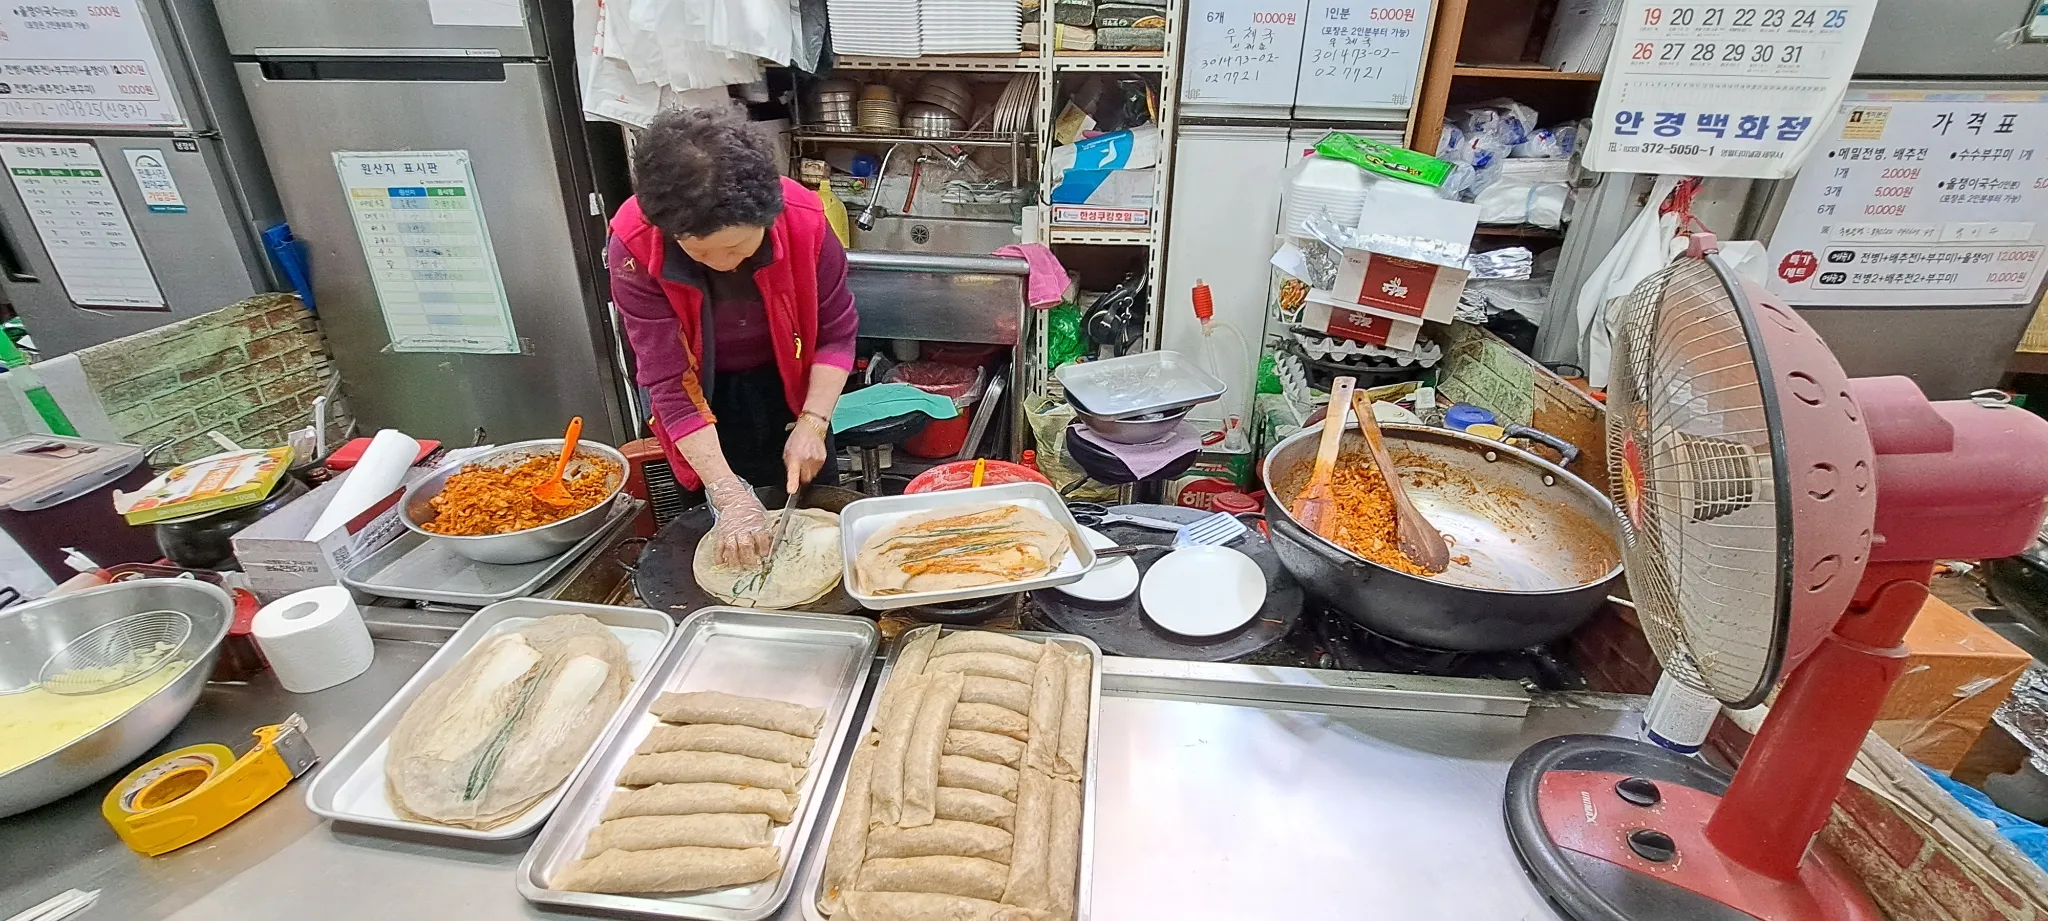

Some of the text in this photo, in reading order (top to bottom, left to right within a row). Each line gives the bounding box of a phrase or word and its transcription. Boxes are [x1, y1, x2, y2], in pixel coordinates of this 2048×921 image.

[1206, 12, 1297, 25] 6개 10,000원
[1325, 7, 1415, 22] 1인분 5,000원
[1643, 8, 1848, 28] 19 20 21 22 23 24 25
[1351, 27, 1388, 37] 2인분부터
[1391, 28, 1410, 38] 가능)
[1631, 42, 1654, 60] 26
[1659, 43, 1685, 61] 27
[1690, 44, 1716, 62] 28
[1722, 44, 1746, 62] 29
[1751, 44, 1774, 62] 30
[1781, 45, 1803, 64] 31
[1614, 110, 1813, 142] 안경백화점
[1641, 142, 1715, 156] 372-5050~1
[1893, 148, 1929, 161] 배추전
[1958, 148, 2034, 161] 수수부꾸미 1개
[361, 162, 438, 175] 원산지 표시판
[1834, 167, 1922, 180] 1개 2,000원
[1823, 186, 1914, 198] 3개 5,000원
[1079, 210, 1133, 222] 한성쿠킹호일
[1817, 204, 1906, 216] 6개 10,000원
[1997, 251, 2037, 263] 12,000원
[1986, 271, 2026, 283] 10,000원
